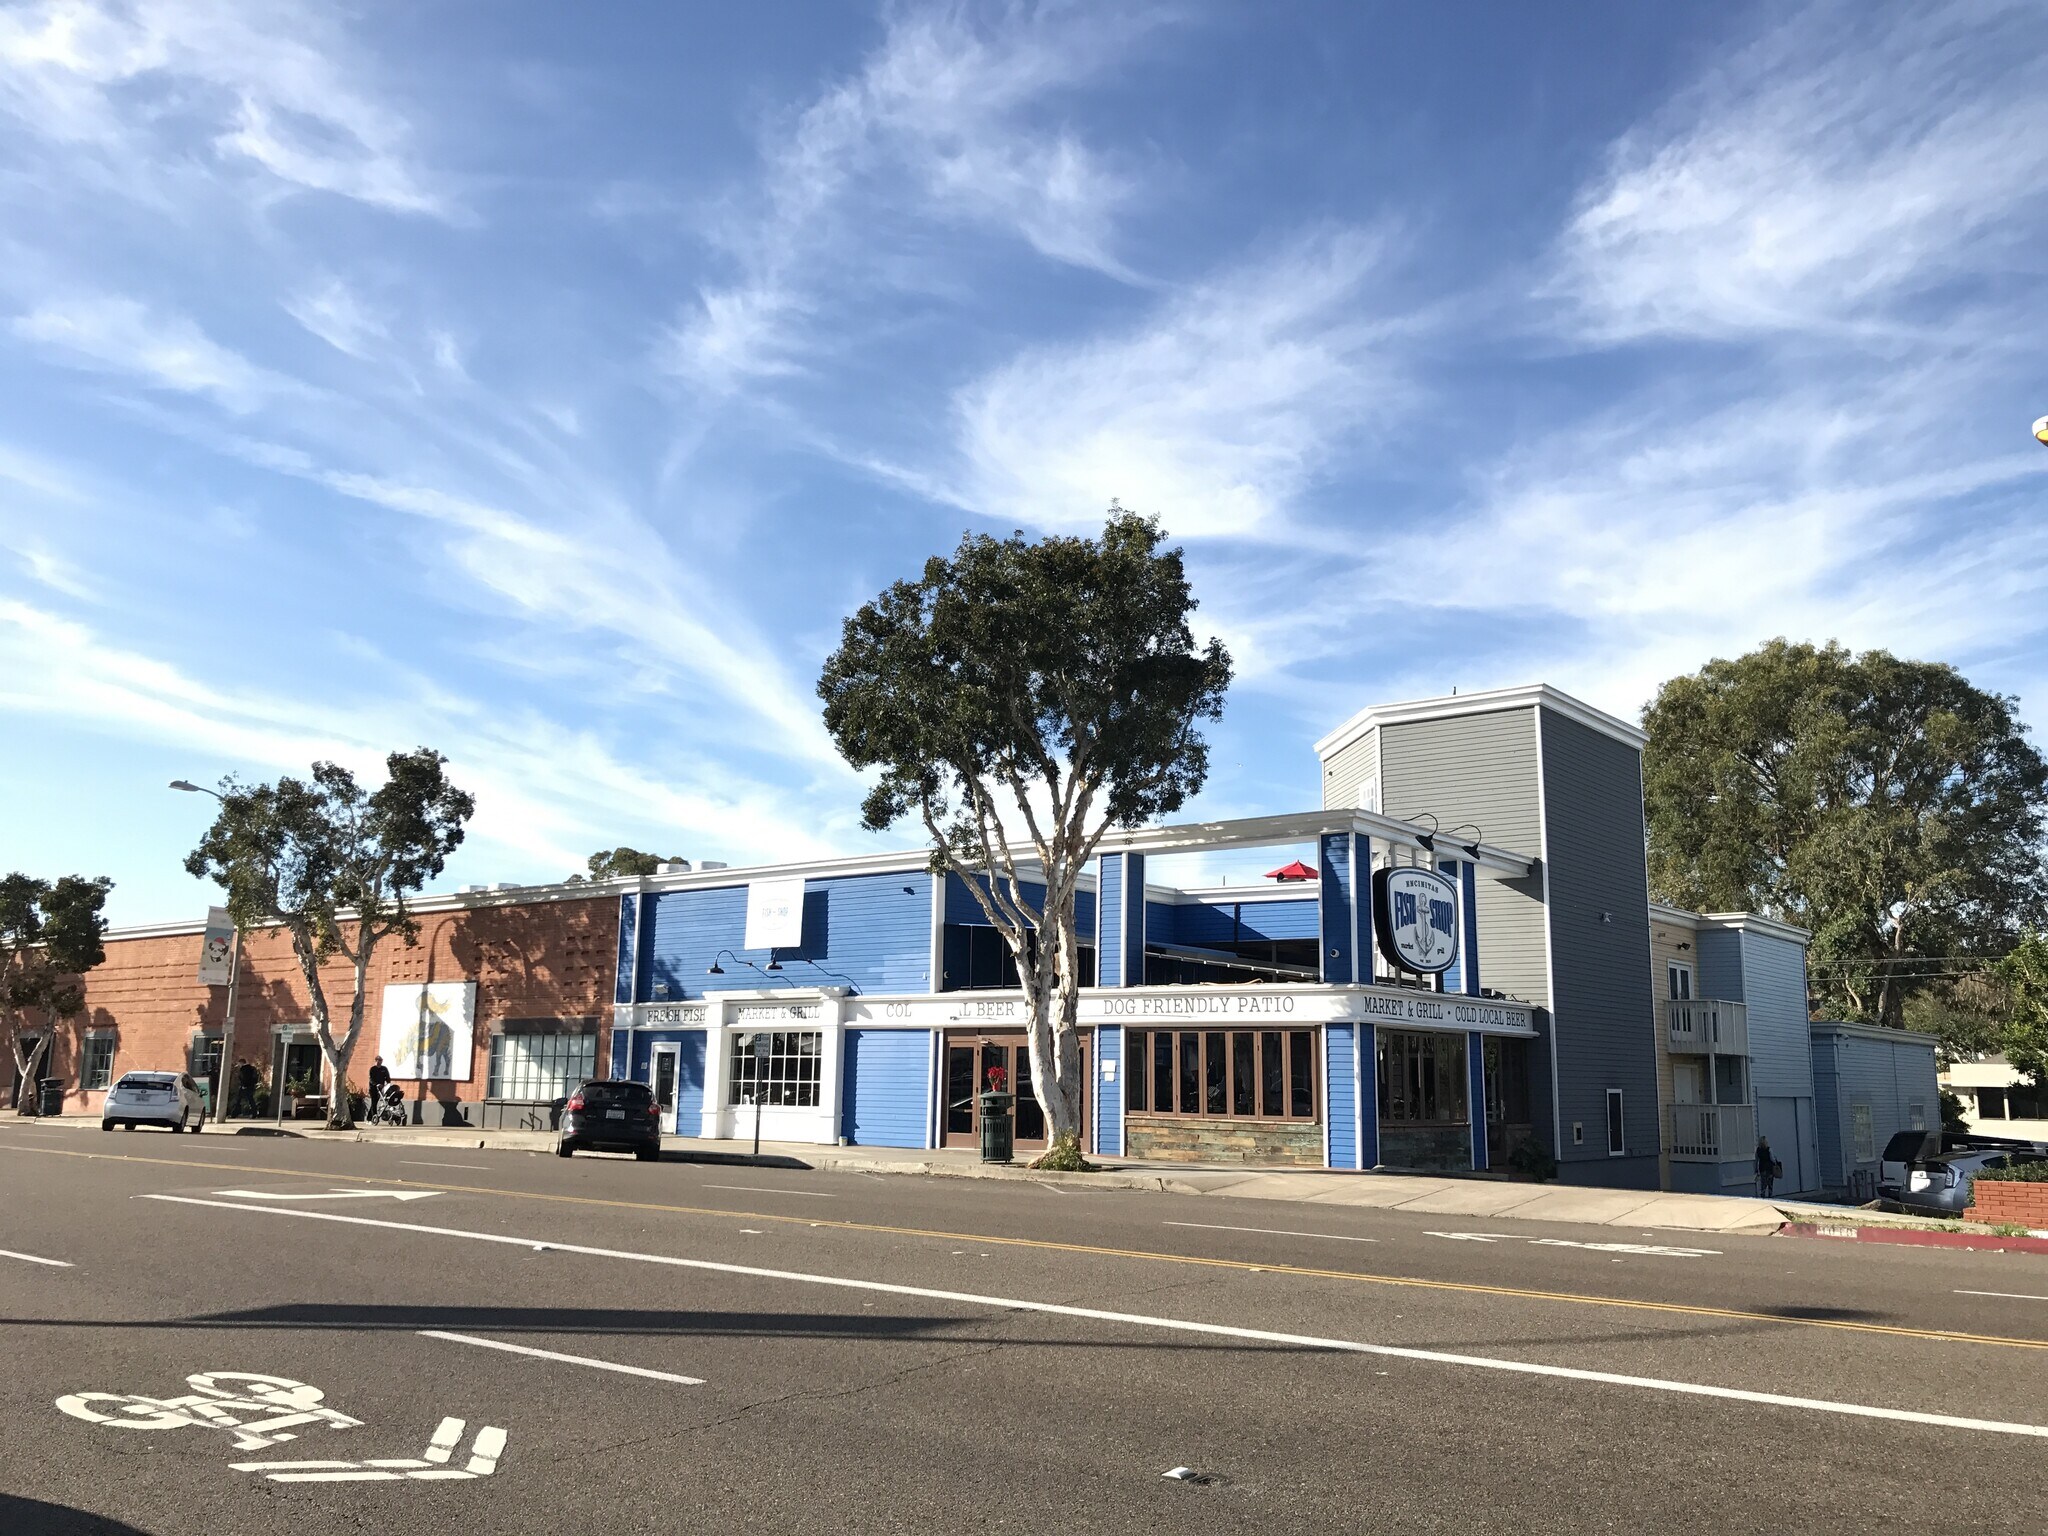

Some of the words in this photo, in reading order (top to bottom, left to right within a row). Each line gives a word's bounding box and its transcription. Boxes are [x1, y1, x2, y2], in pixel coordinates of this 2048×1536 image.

[1406, 881, 1439, 893] ENCINITAS
[1394, 891, 1416, 931] FISH
[1429, 899, 1453, 938] SHOP
[738, 1007, 777, 1019] MARKET
[789, 1006, 819, 1019] GRILL
[886, 1003, 912, 1018] COL
[976, 1002, 1015, 1017] BEER
[1104, 999, 1136, 1014] DOG
[1142, 998, 1230, 1014] FRIENDLY
[1238, 996, 1294, 1012] PATIO
[1364, 997, 1404, 1017] MARKET
[1408, 1001, 1413, 1018] &
[1416, 1001, 1443, 1020] GRILL
[1455, 1006, 1477, 1023] COLD
[1479, 1008, 1504, 1025] LOCAL
[1506, 1011, 1526, 1028] BEER
[647, 1009, 680, 1022] FRESH
[683, 1008, 706, 1021] FISH
